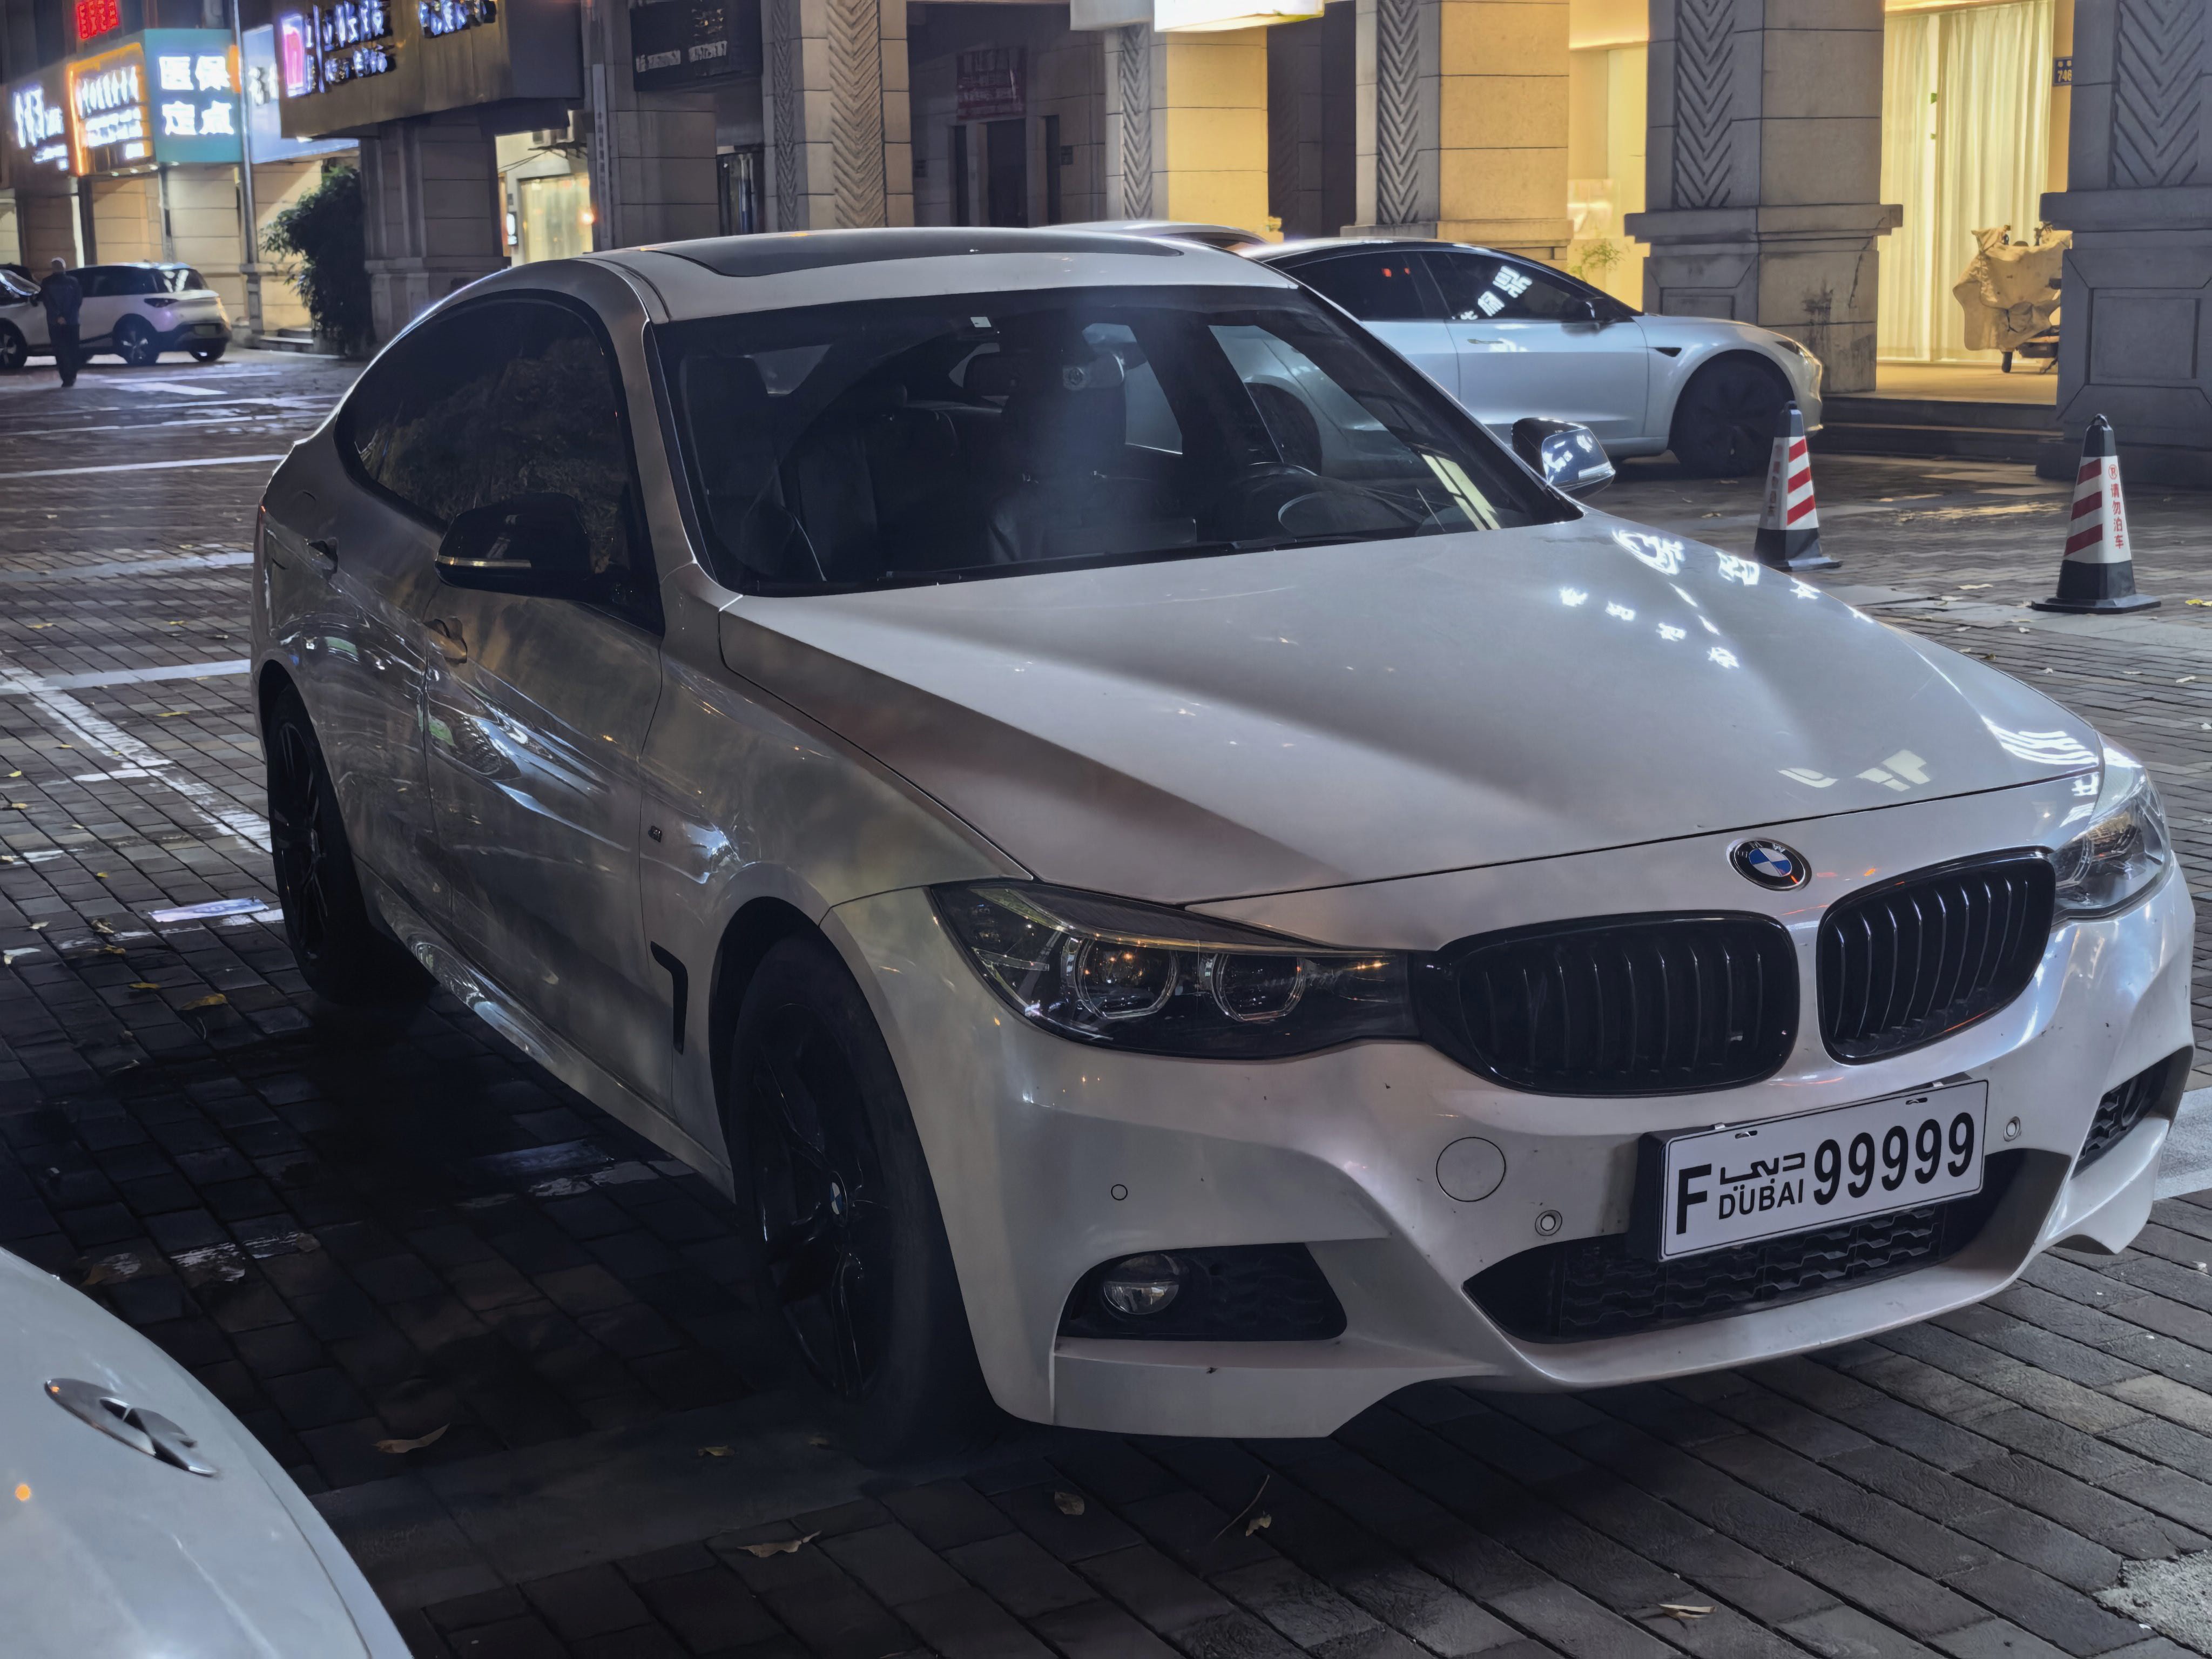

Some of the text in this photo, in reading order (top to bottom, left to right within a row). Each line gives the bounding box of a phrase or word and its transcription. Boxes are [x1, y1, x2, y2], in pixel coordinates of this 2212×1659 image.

[2110, 483, 2124, 549] 请勿泊车
[1813, 1112, 1974, 1205] 99999
[1676, 1163, 1711, 1235] F
[1719, 1179, 1804, 1220] DUBAI
